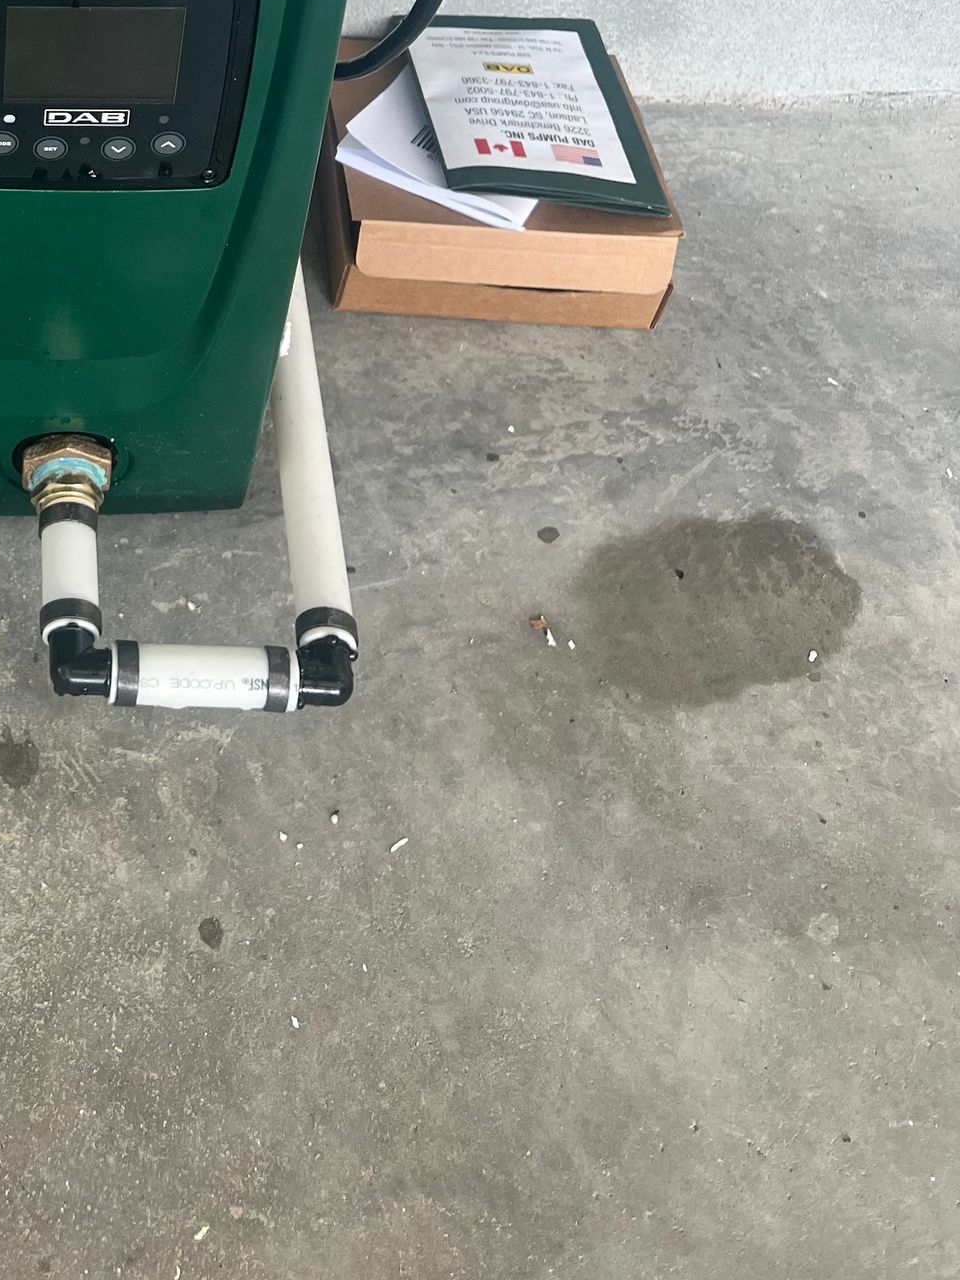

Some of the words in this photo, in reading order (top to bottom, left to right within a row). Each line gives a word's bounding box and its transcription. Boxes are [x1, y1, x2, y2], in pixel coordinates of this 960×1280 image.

[464, 107, 488, 115] USA
[491, 109, 525, 118] 29456
[529, 111, 544, 119] SC
[48, 112, 126, 123] DAB
[545, 112, 587, 124] Ladson,
[469, 118, 497, 127] Drive
[500, 121, 561, 132] Benchmark
[501, 130, 525, 139] INC.
[529, 134, 569, 144] PUMPS
[573, 139, 595, 148] DAB
